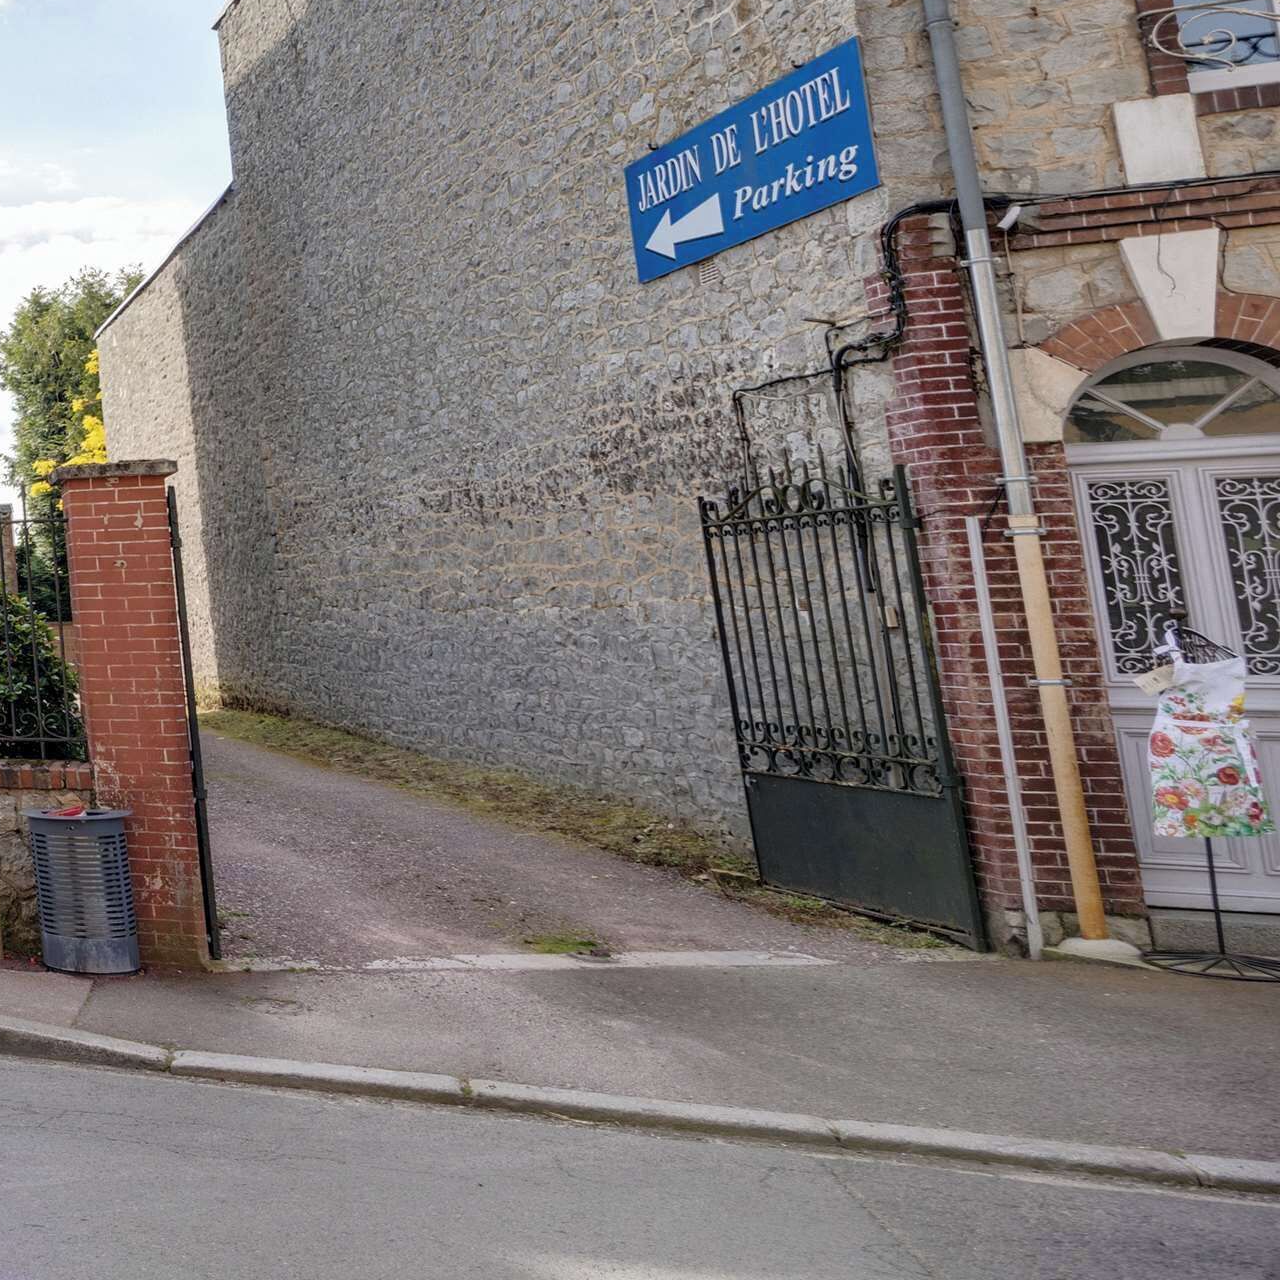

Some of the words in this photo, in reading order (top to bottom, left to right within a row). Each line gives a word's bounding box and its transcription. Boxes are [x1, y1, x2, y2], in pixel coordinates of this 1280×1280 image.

[638, 144, 702, 212] JARDIN
[711, 124, 741, 175] DE
[750, 67, 851, 155] L'HOTEL
[733, 144, 859, 220] Parking
